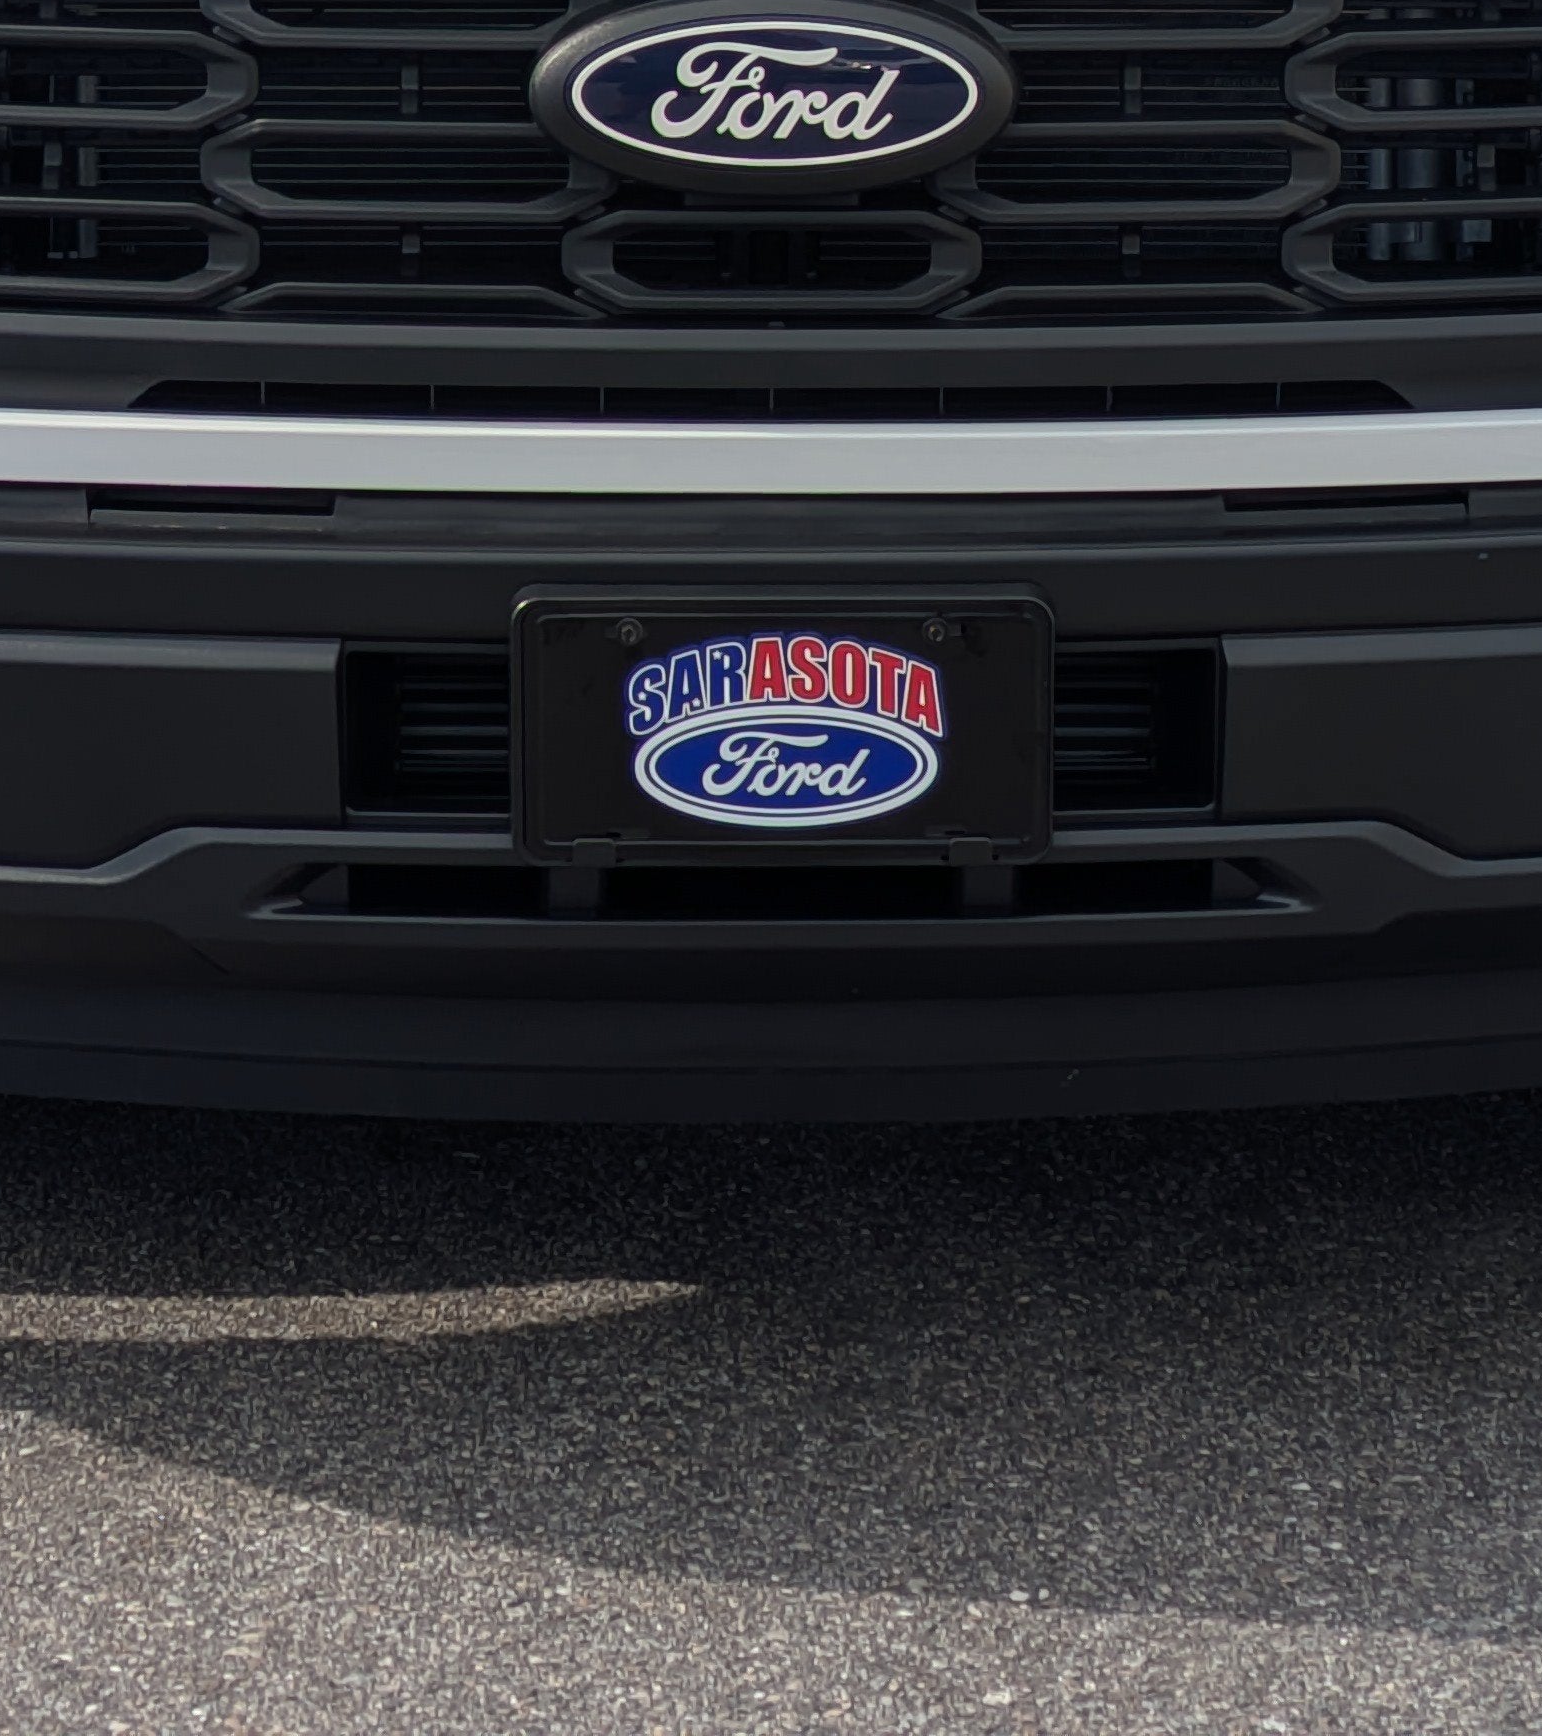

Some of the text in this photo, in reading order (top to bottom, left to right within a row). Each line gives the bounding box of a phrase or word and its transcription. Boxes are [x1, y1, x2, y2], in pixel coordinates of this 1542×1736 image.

[651, 41, 901, 141] Ford
[627, 635, 946, 739] SARASOTA
[701, 730, 871, 797] Ford
